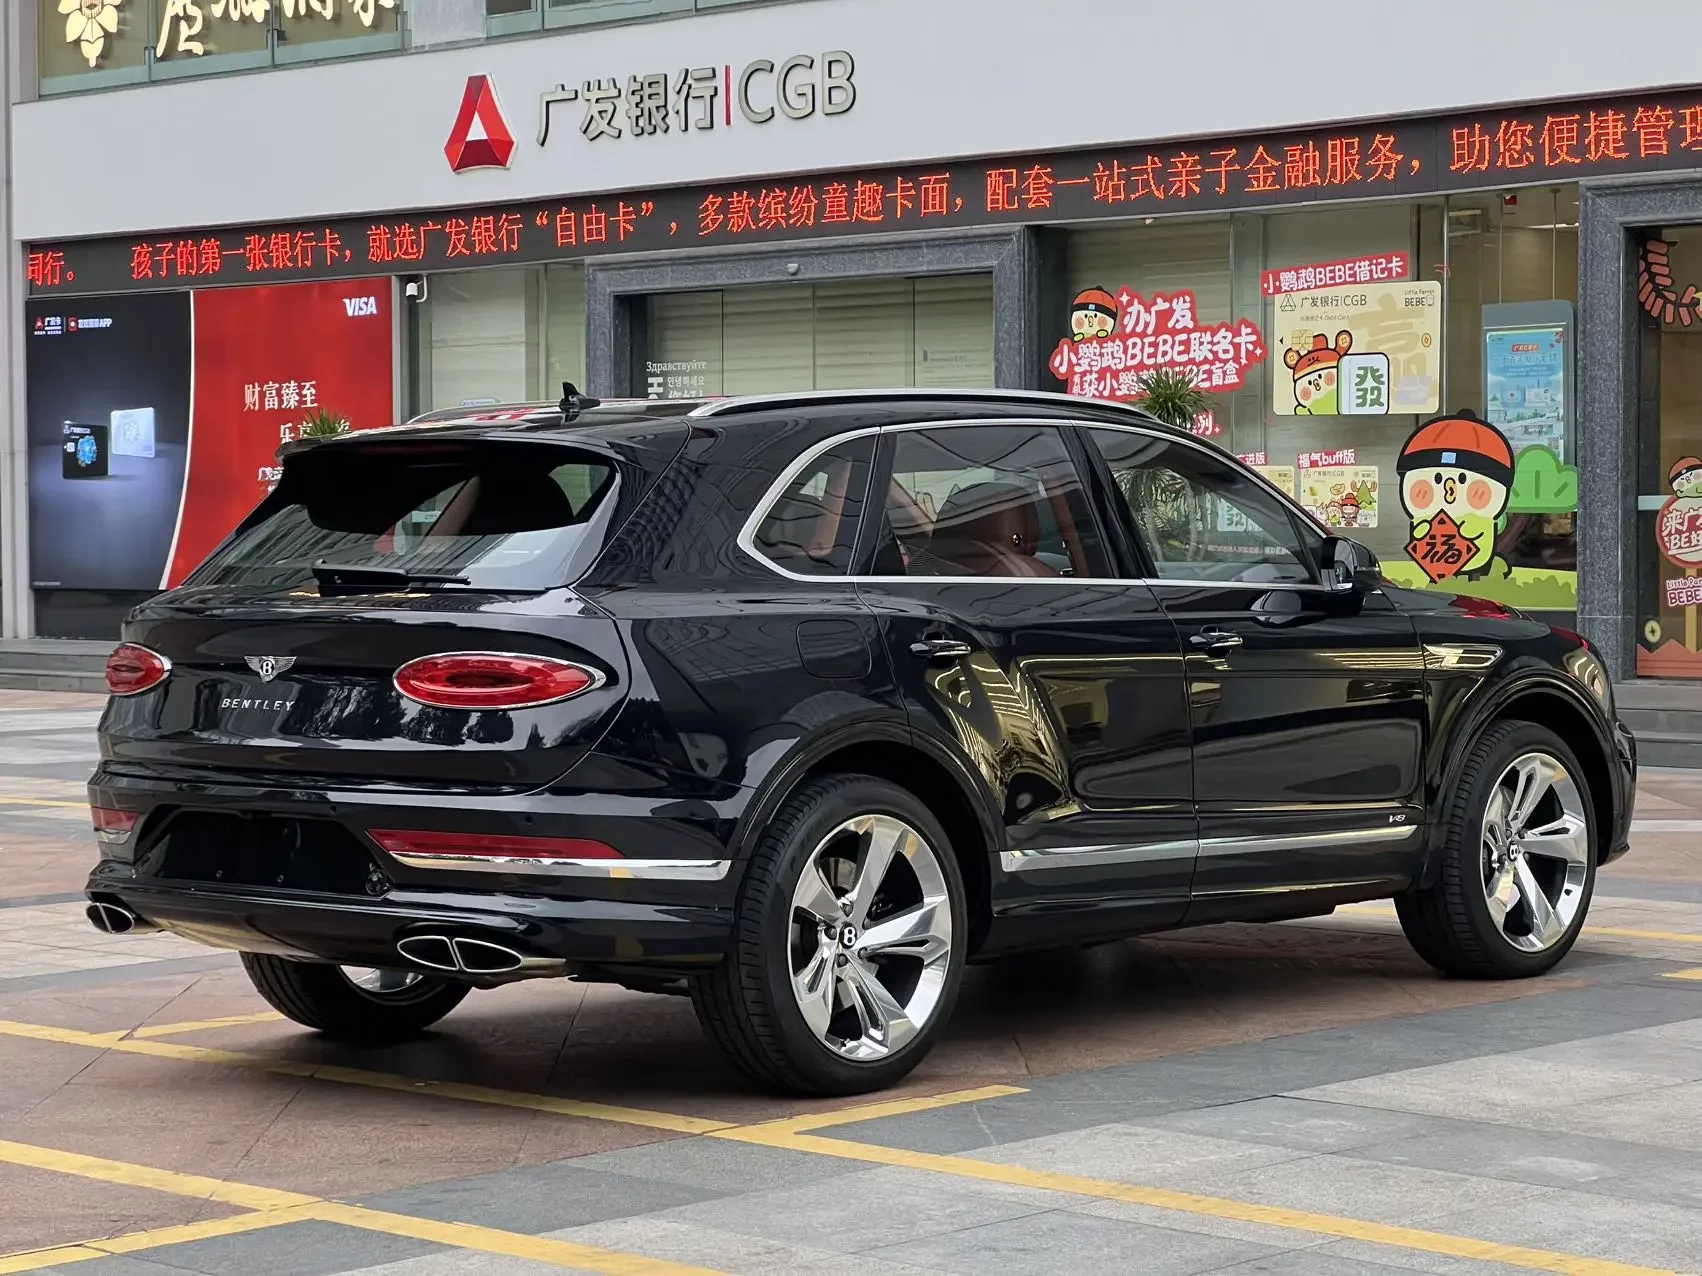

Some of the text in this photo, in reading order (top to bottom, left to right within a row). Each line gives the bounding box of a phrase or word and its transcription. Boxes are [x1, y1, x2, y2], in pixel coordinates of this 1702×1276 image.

[536, 50, 857, 147] 广发银行 CGB
[1263, 255, 1404, 294] 小鹦鹉BEBE借记卡
[342, 296, 377, 316] VISA
[1300, 294, 1367, 309] 广发银行 CGB
[1404, 297, 1426, 307] BEBE
[1122, 295, 1195, 334] 办广发
[1053, 323, 1258, 374] 小鹦鹉BEBE联名卡
[243, 379, 318, 412] 财富臻至
[1298, 448, 1356, 468] 福气buff版
[221, 698, 295, 711] BENTLEY
[1389, 814, 1406, 823] V8
